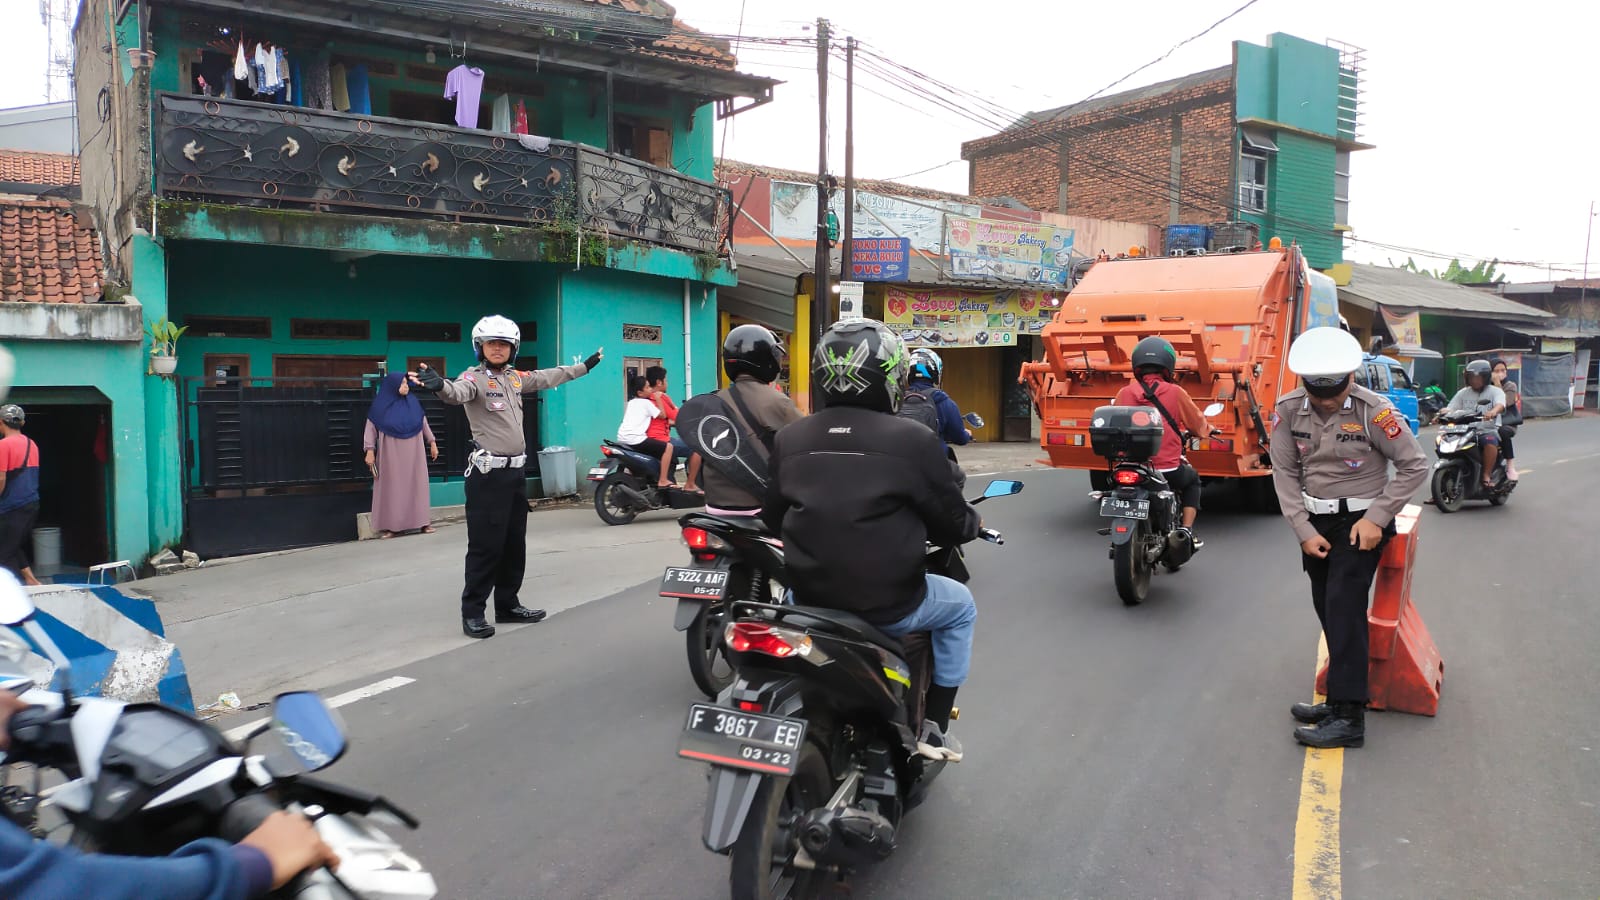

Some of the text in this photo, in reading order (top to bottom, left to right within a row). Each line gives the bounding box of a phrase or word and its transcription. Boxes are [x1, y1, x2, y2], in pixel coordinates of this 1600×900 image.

[853, 252, 878, 262] NEKA
[912, 291, 956, 311] Love
[667, 570, 725, 584] F 5224 AAF
[692, 710, 798, 747] F 3867 EE
